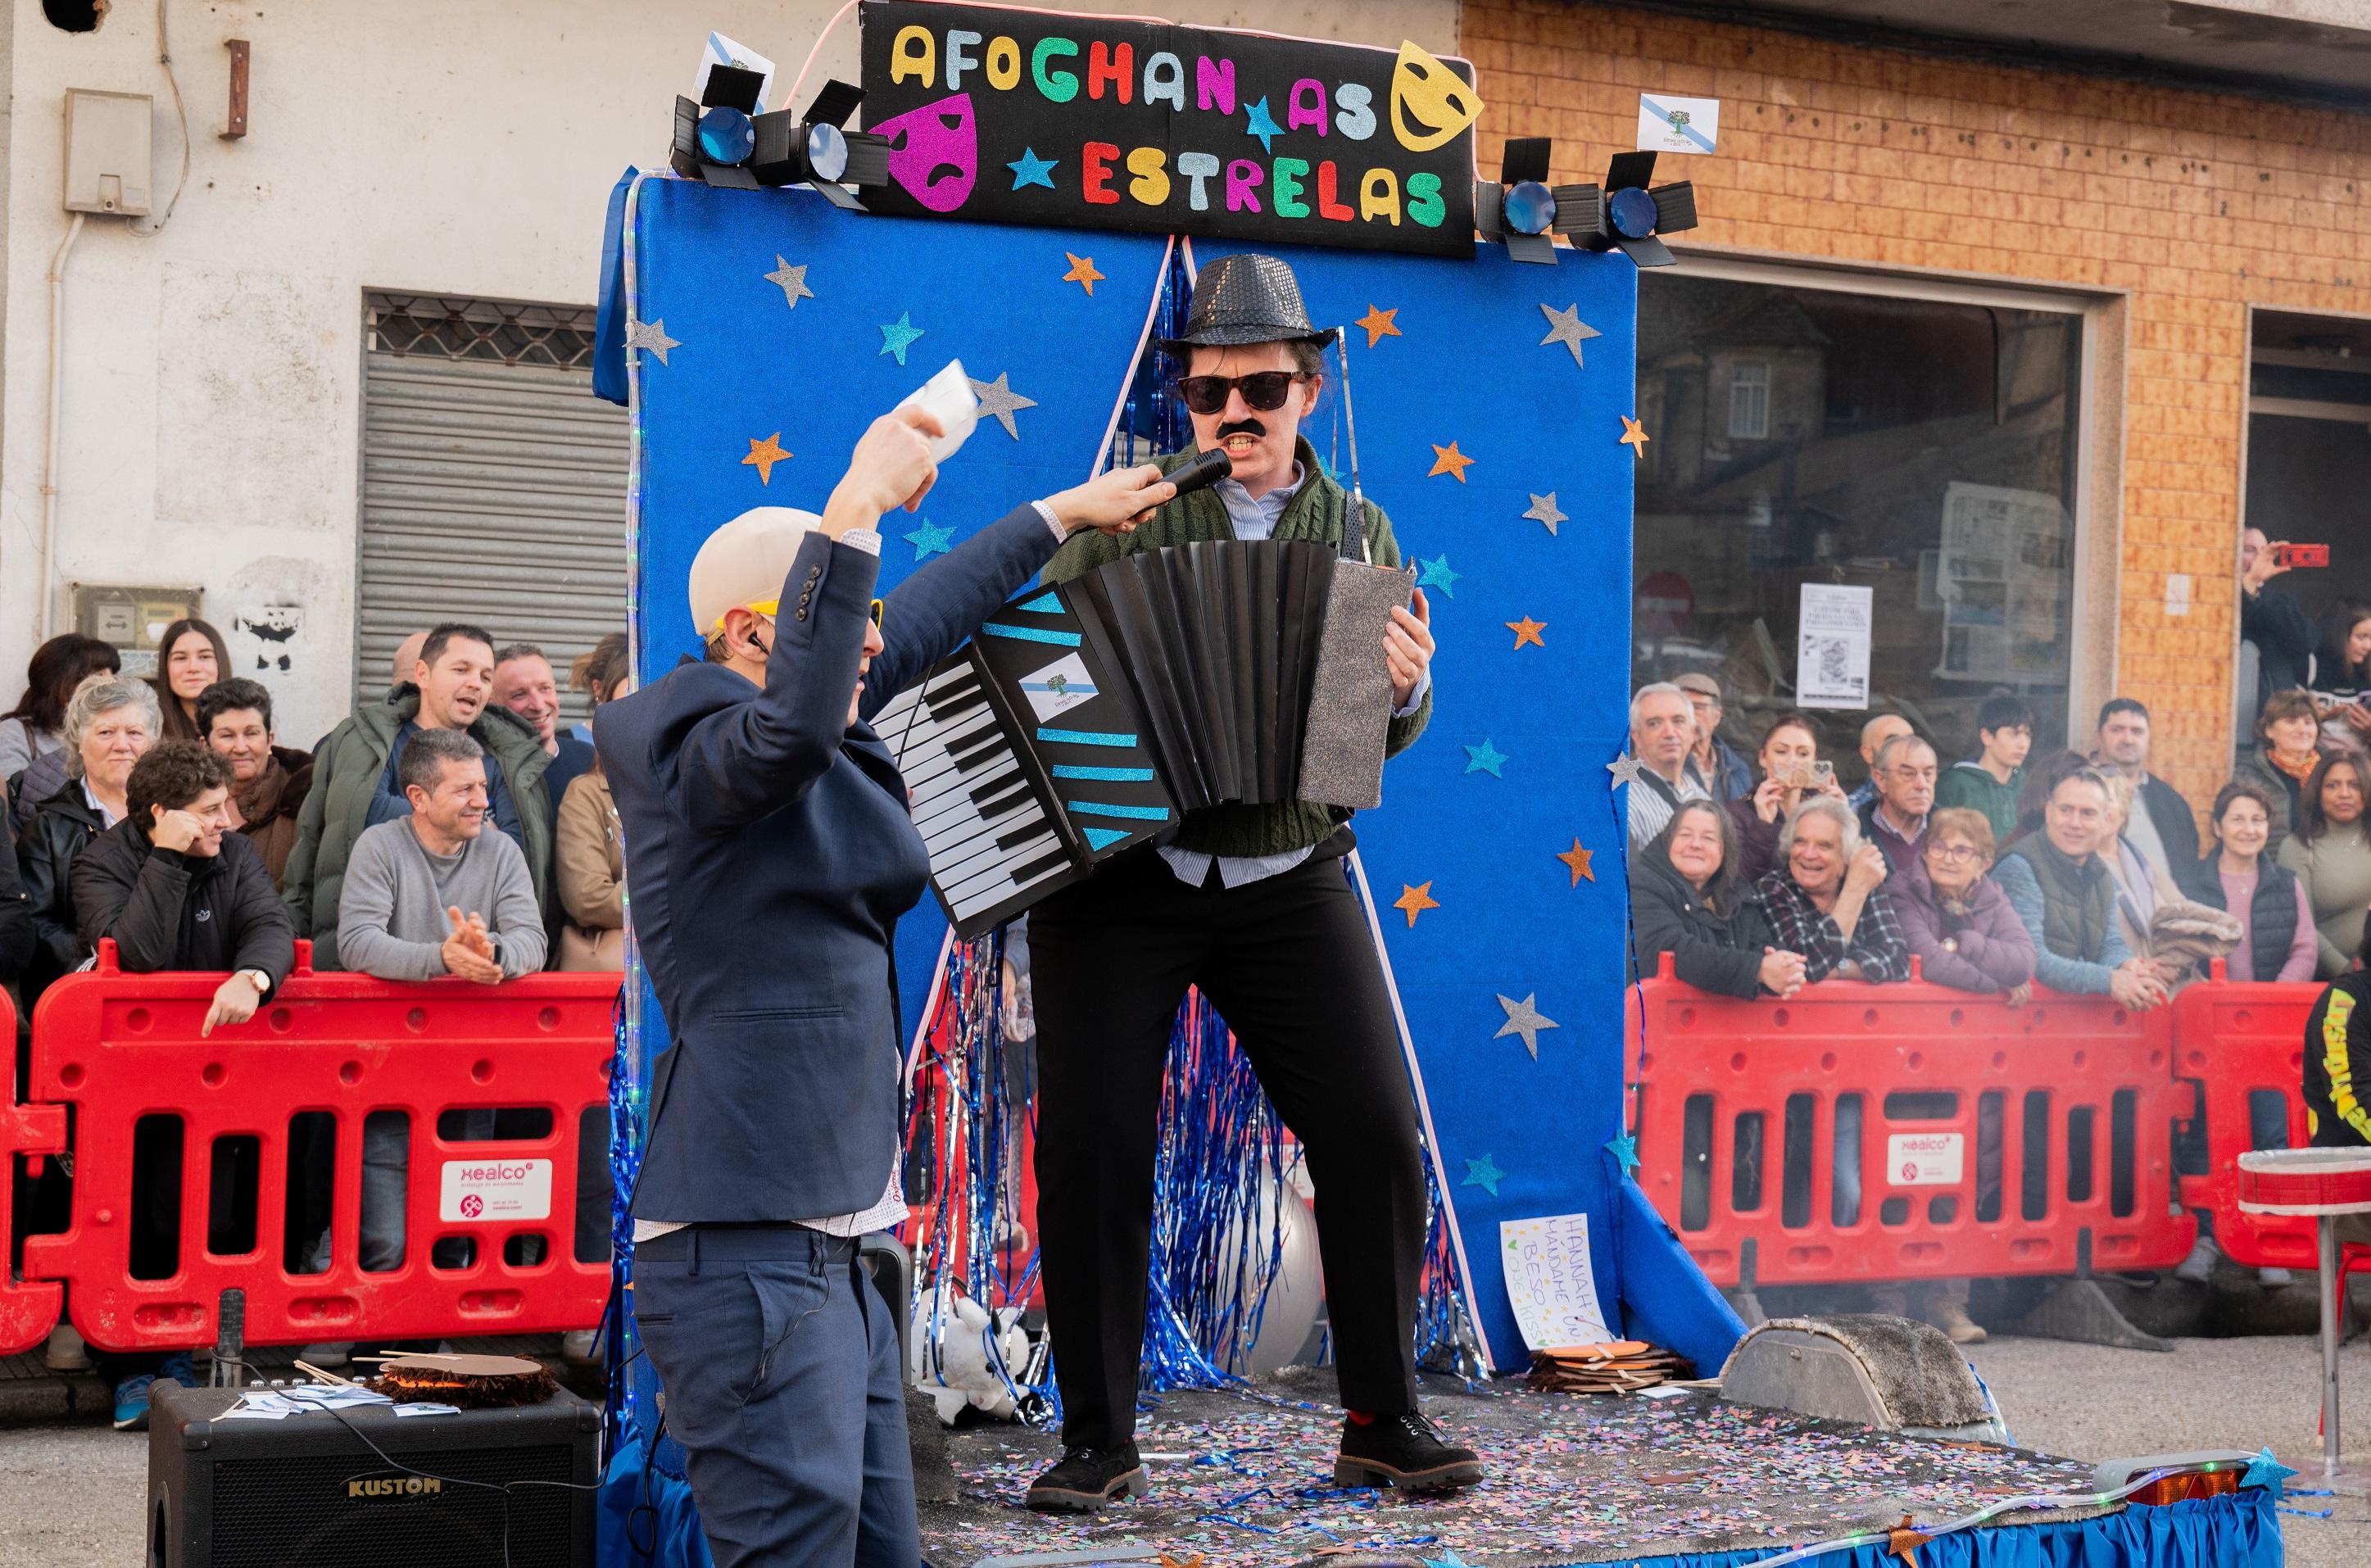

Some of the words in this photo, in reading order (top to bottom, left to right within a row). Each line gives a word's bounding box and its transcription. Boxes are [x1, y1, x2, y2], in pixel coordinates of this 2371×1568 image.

[891, 25, 1235, 115] AFOGHAN
[1288, 78, 1377, 140] AS
[1082, 142, 1446, 228] ESTRELAS
[460, 1162, 526, 1181] xealco
[1508, 1256, 1525, 1292] ONE
[1519, 1306, 1543, 1339] KISS
[1524, 1240, 1545, 1306] BESO
[1545, 1219, 1570, 1304] MÁNDAME
[1562, 1316, 1580, 1337] UN
[1566, 1218, 1592, 1308] HANNAH
[348, 1477, 441, 1498] KUSTOM
